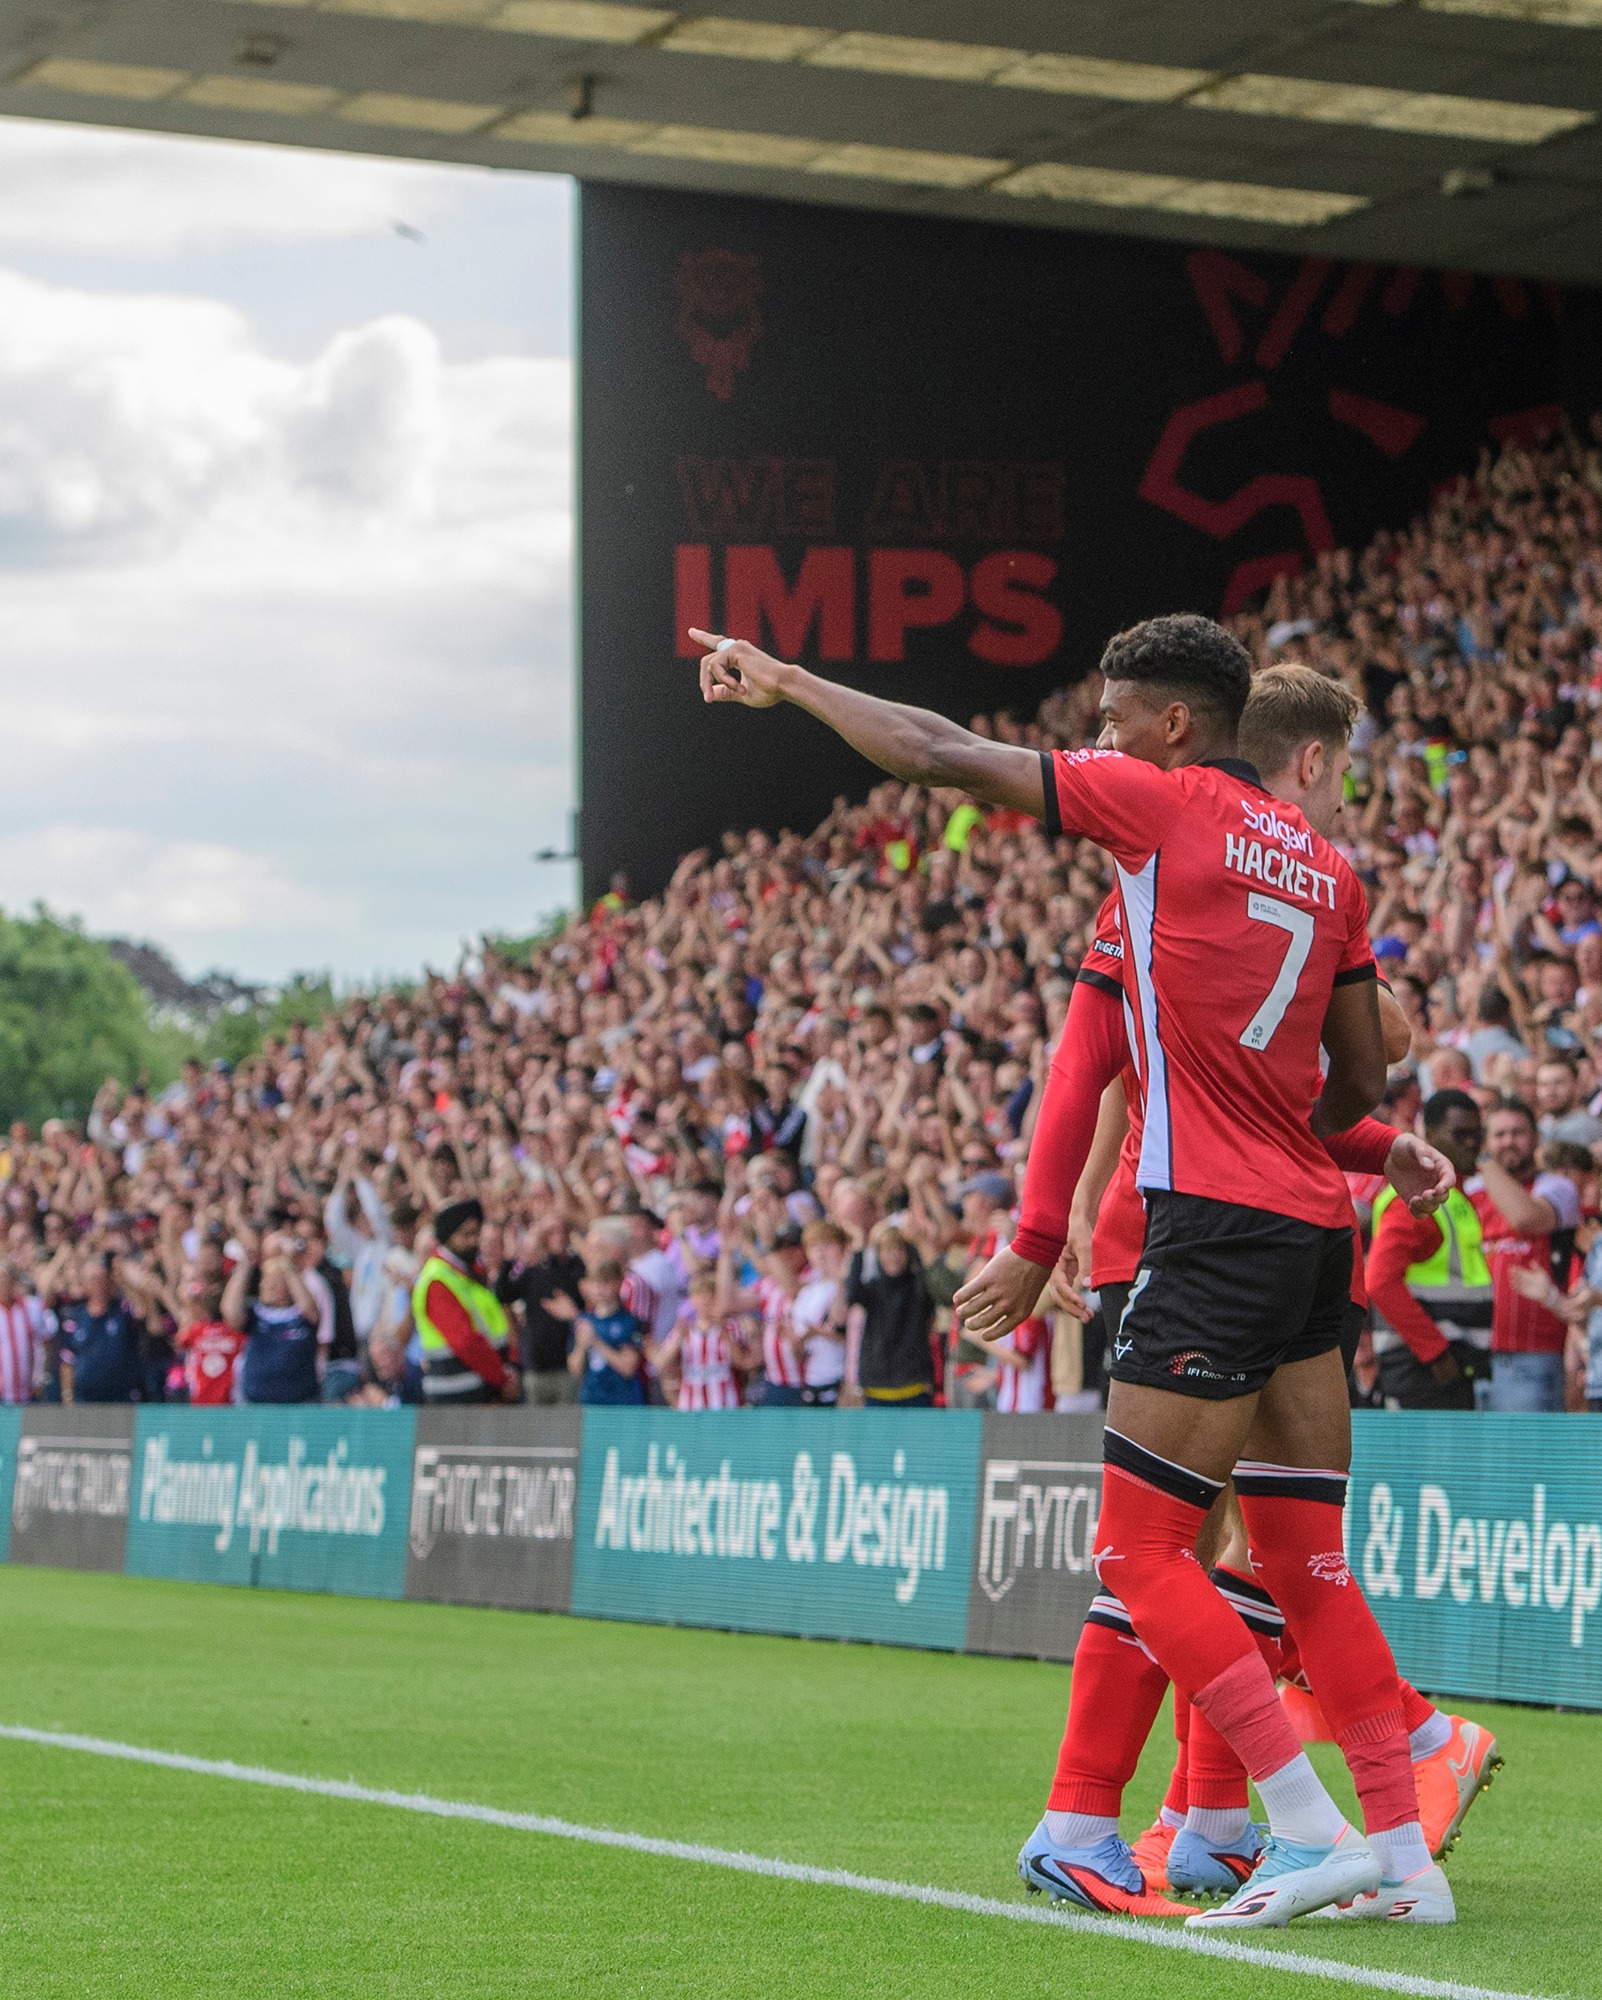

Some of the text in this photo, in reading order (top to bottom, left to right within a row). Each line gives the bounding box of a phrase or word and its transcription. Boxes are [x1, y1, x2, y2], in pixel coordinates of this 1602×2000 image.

[676, 455, 1065, 540] WE ARE
[673, 542, 1062, 666] IMPS
[1225, 832, 1337, 911] HACKETT
[1241, 800, 1314, 858] Solgari
[1238, 891, 1315, 1051] 7
[1187, 1367, 1200, 1376] IFI
[1201, 1370, 1230, 1380] GRO
[595, 1442, 948, 1603] Architecture & Design
[1363, 1483, 1404, 1597] &
[1415, 1483, 1602, 1648] Develop
